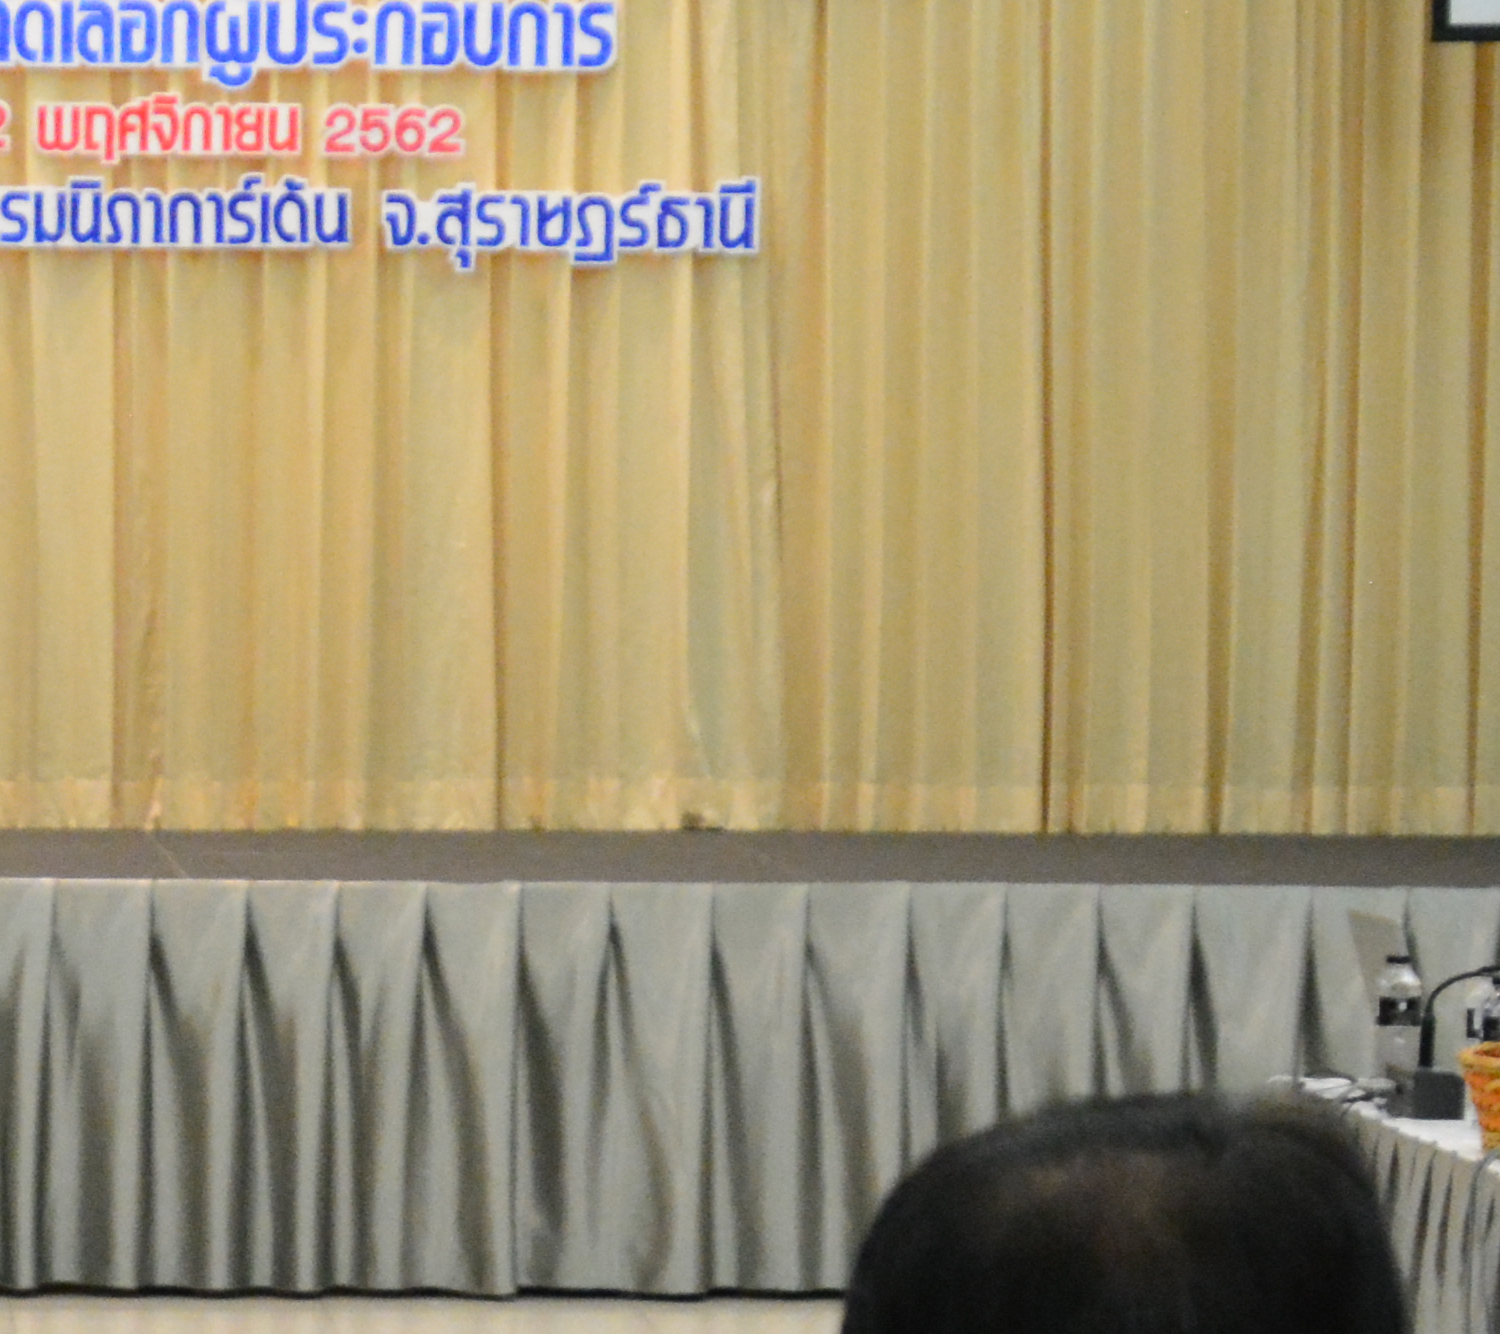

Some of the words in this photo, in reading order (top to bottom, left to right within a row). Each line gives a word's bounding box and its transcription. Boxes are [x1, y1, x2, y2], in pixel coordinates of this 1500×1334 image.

[37, 94, 299, 161] พฤศจิกายน
[325, 107, 462, 153] 2562
[385, 181, 757, 269] จ.สุราษฎร์ธานี
